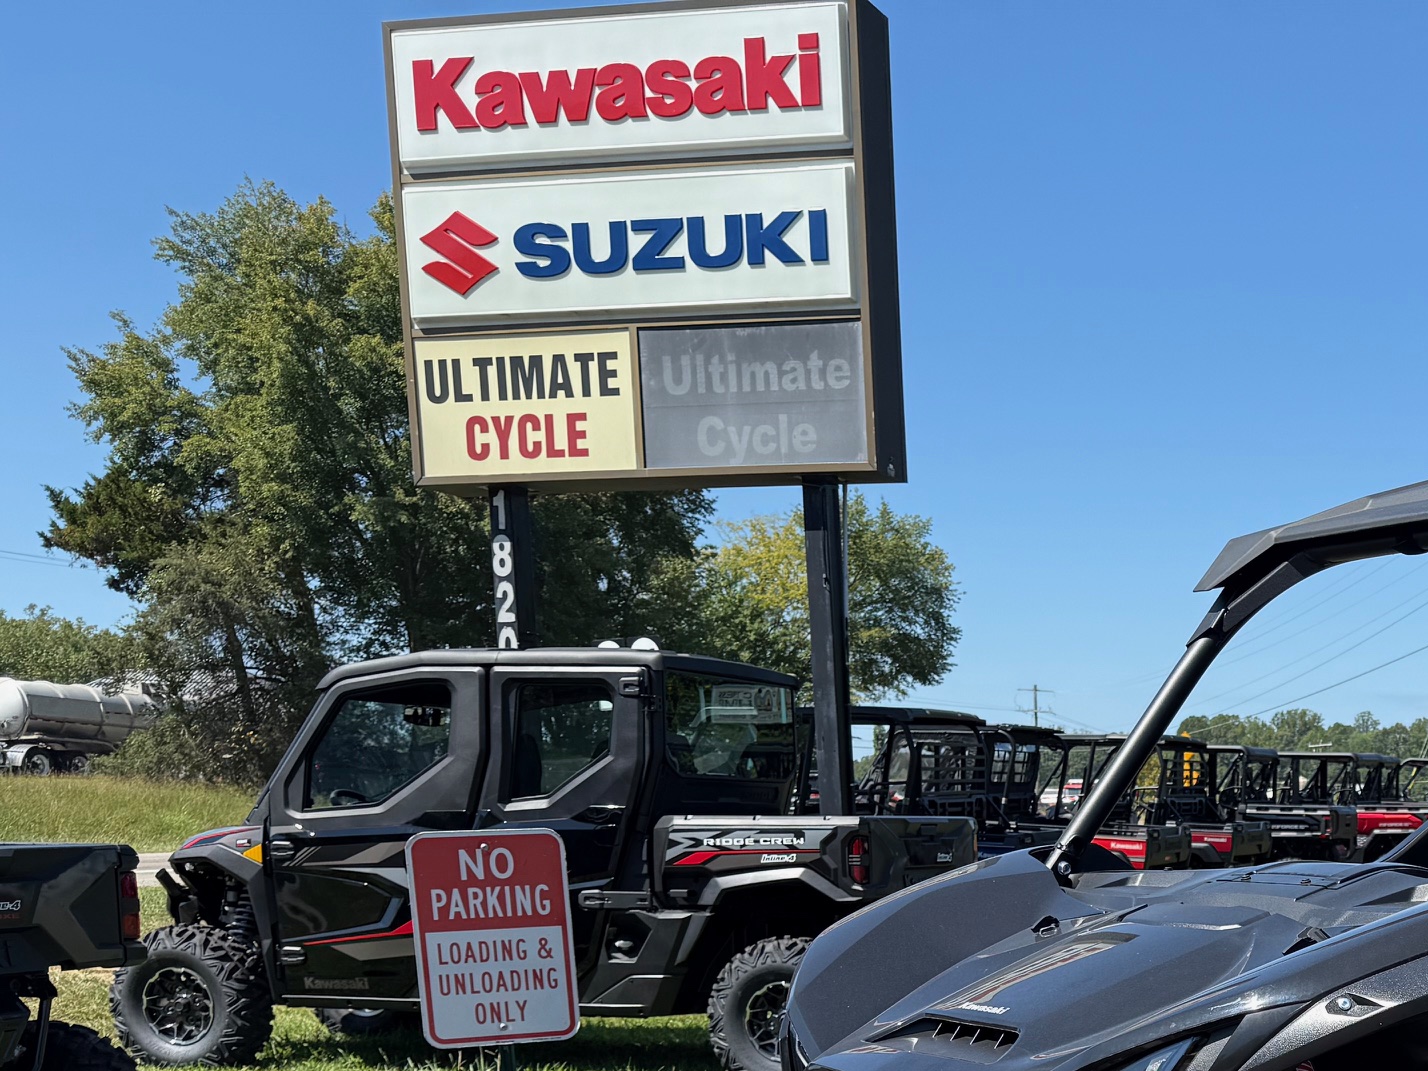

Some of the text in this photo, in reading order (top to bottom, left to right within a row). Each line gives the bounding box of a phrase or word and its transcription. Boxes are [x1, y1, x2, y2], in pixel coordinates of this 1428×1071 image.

[411, 33, 822, 131] Kawasaki
[513, 208, 828, 278] SUZUKI
[423, 351, 621, 404] ULTIMATE
[661, 350, 851, 397] Ultimate
[465, 412, 590, 462] CYCLE
[697, 414, 817, 465] Cycle
[703, 837, 805, 846] RIDGE CREW
[1110, 841, 1143, 850] Kawasaki
[458, 847, 515, 881] NO
[430, 884, 551, 921] PARKING
[437, 937, 554, 966] LOADING &
[304, 977, 369, 990] Kawasaki
[438, 967, 559, 996] UNLOADING
[475, 1000, 528, 1025] ONLY
[958, 1001, 1011, 1015] Kawasaki
